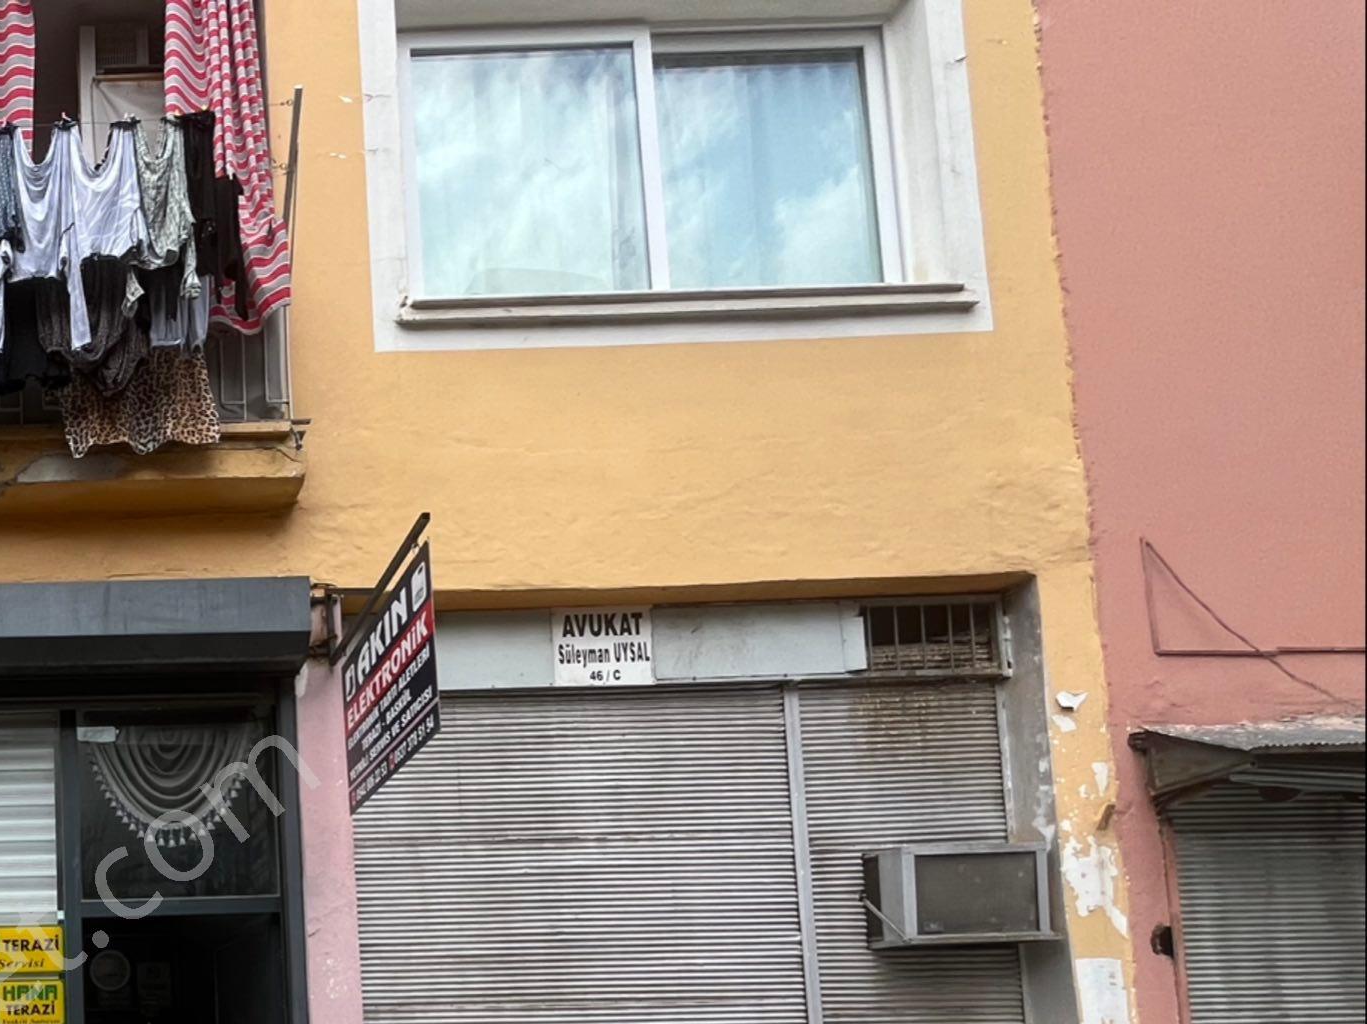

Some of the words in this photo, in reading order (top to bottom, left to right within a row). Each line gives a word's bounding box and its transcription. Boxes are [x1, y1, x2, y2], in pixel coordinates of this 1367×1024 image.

[562, 612, 642, 637] AVUKAT
[356, 583, 408, 688] AKIN
[558, 644, 610, 668] Süleyman
[614, 642, 650, 662] UYSAL
[590, 670, 603, 681] 46
[613, 669, 621, 680] C
[2, 934, 60, 952] TERAZİ
[6, 1001, 55, 1016] TERAZİ
